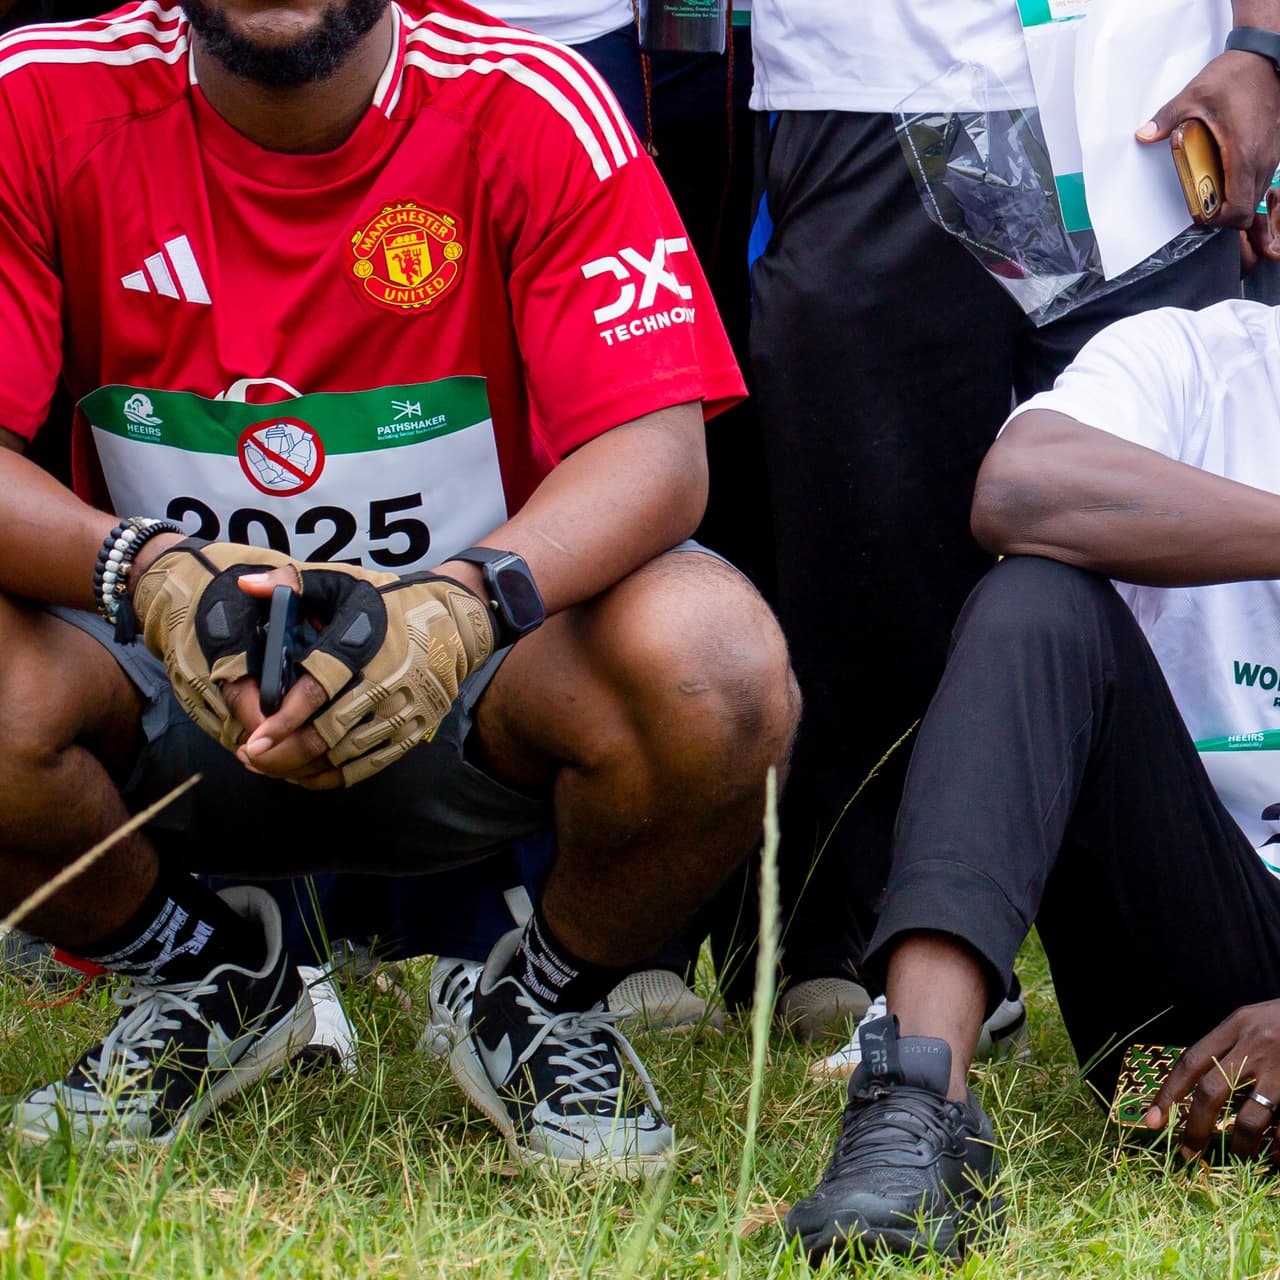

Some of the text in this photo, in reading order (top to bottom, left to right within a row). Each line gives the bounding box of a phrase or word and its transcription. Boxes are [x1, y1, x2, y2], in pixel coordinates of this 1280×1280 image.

[361, 210, 448, 252] MANCHESTER
[383, 275, 446, 304] UNITED
[126, 423, 162, 437] HEEIRS
[376, 414, 446, 435] PATHSHAKER
[165, 492, 431, 571] 2025
